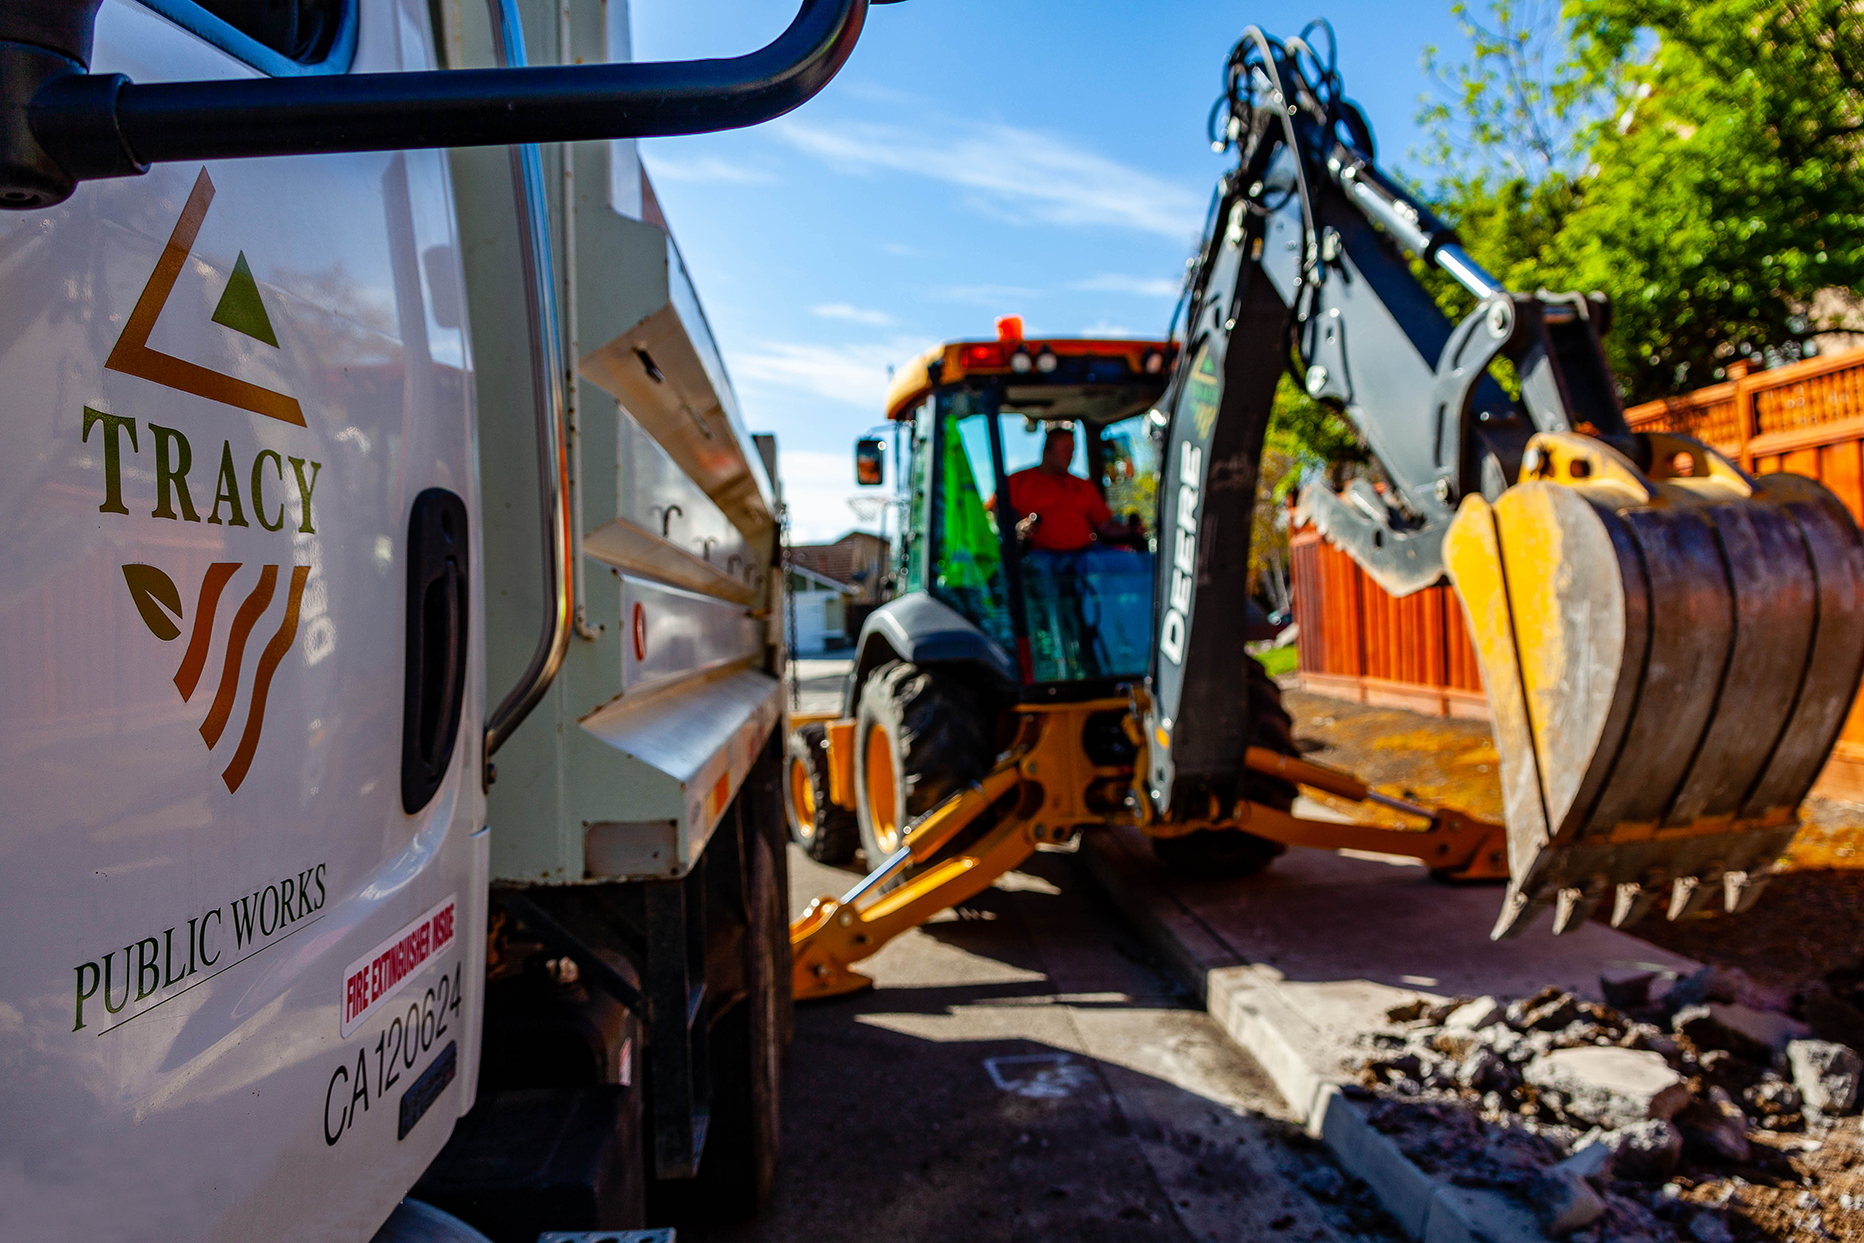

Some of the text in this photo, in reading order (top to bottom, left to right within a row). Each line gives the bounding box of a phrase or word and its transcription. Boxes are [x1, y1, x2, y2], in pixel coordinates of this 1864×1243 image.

[82, 405, 322, 534] TRACY
[1160, 440, 1202, 665] DEERE
[73, 862, 327, 1033] PUBLIC WORKS
[346, 902, 454, 1024] FIRE EXTINGUISHER INSIDE
